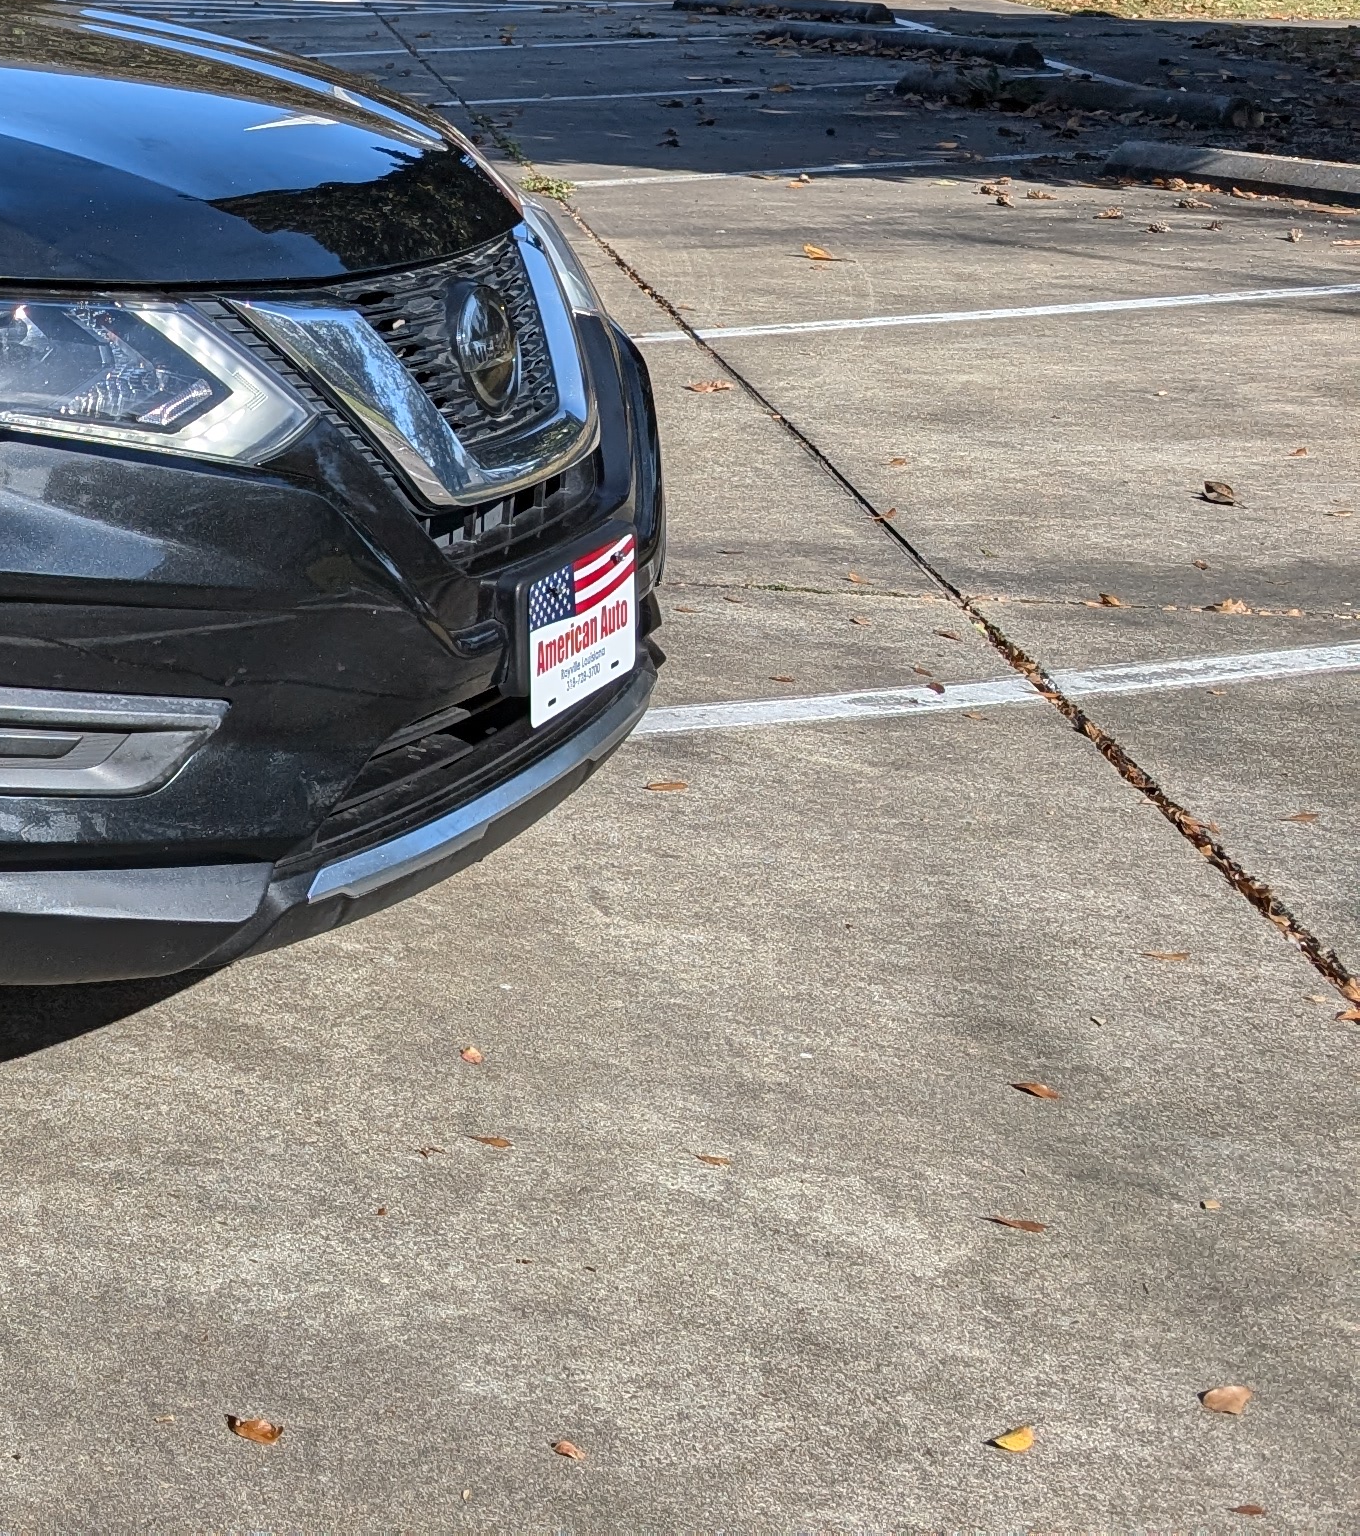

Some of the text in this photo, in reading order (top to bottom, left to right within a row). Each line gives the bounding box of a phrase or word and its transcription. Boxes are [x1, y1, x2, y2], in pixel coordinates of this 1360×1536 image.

[537, 599, 628, 677] American Auto
[561, 647, 606, 680] Rayville Louisiana
